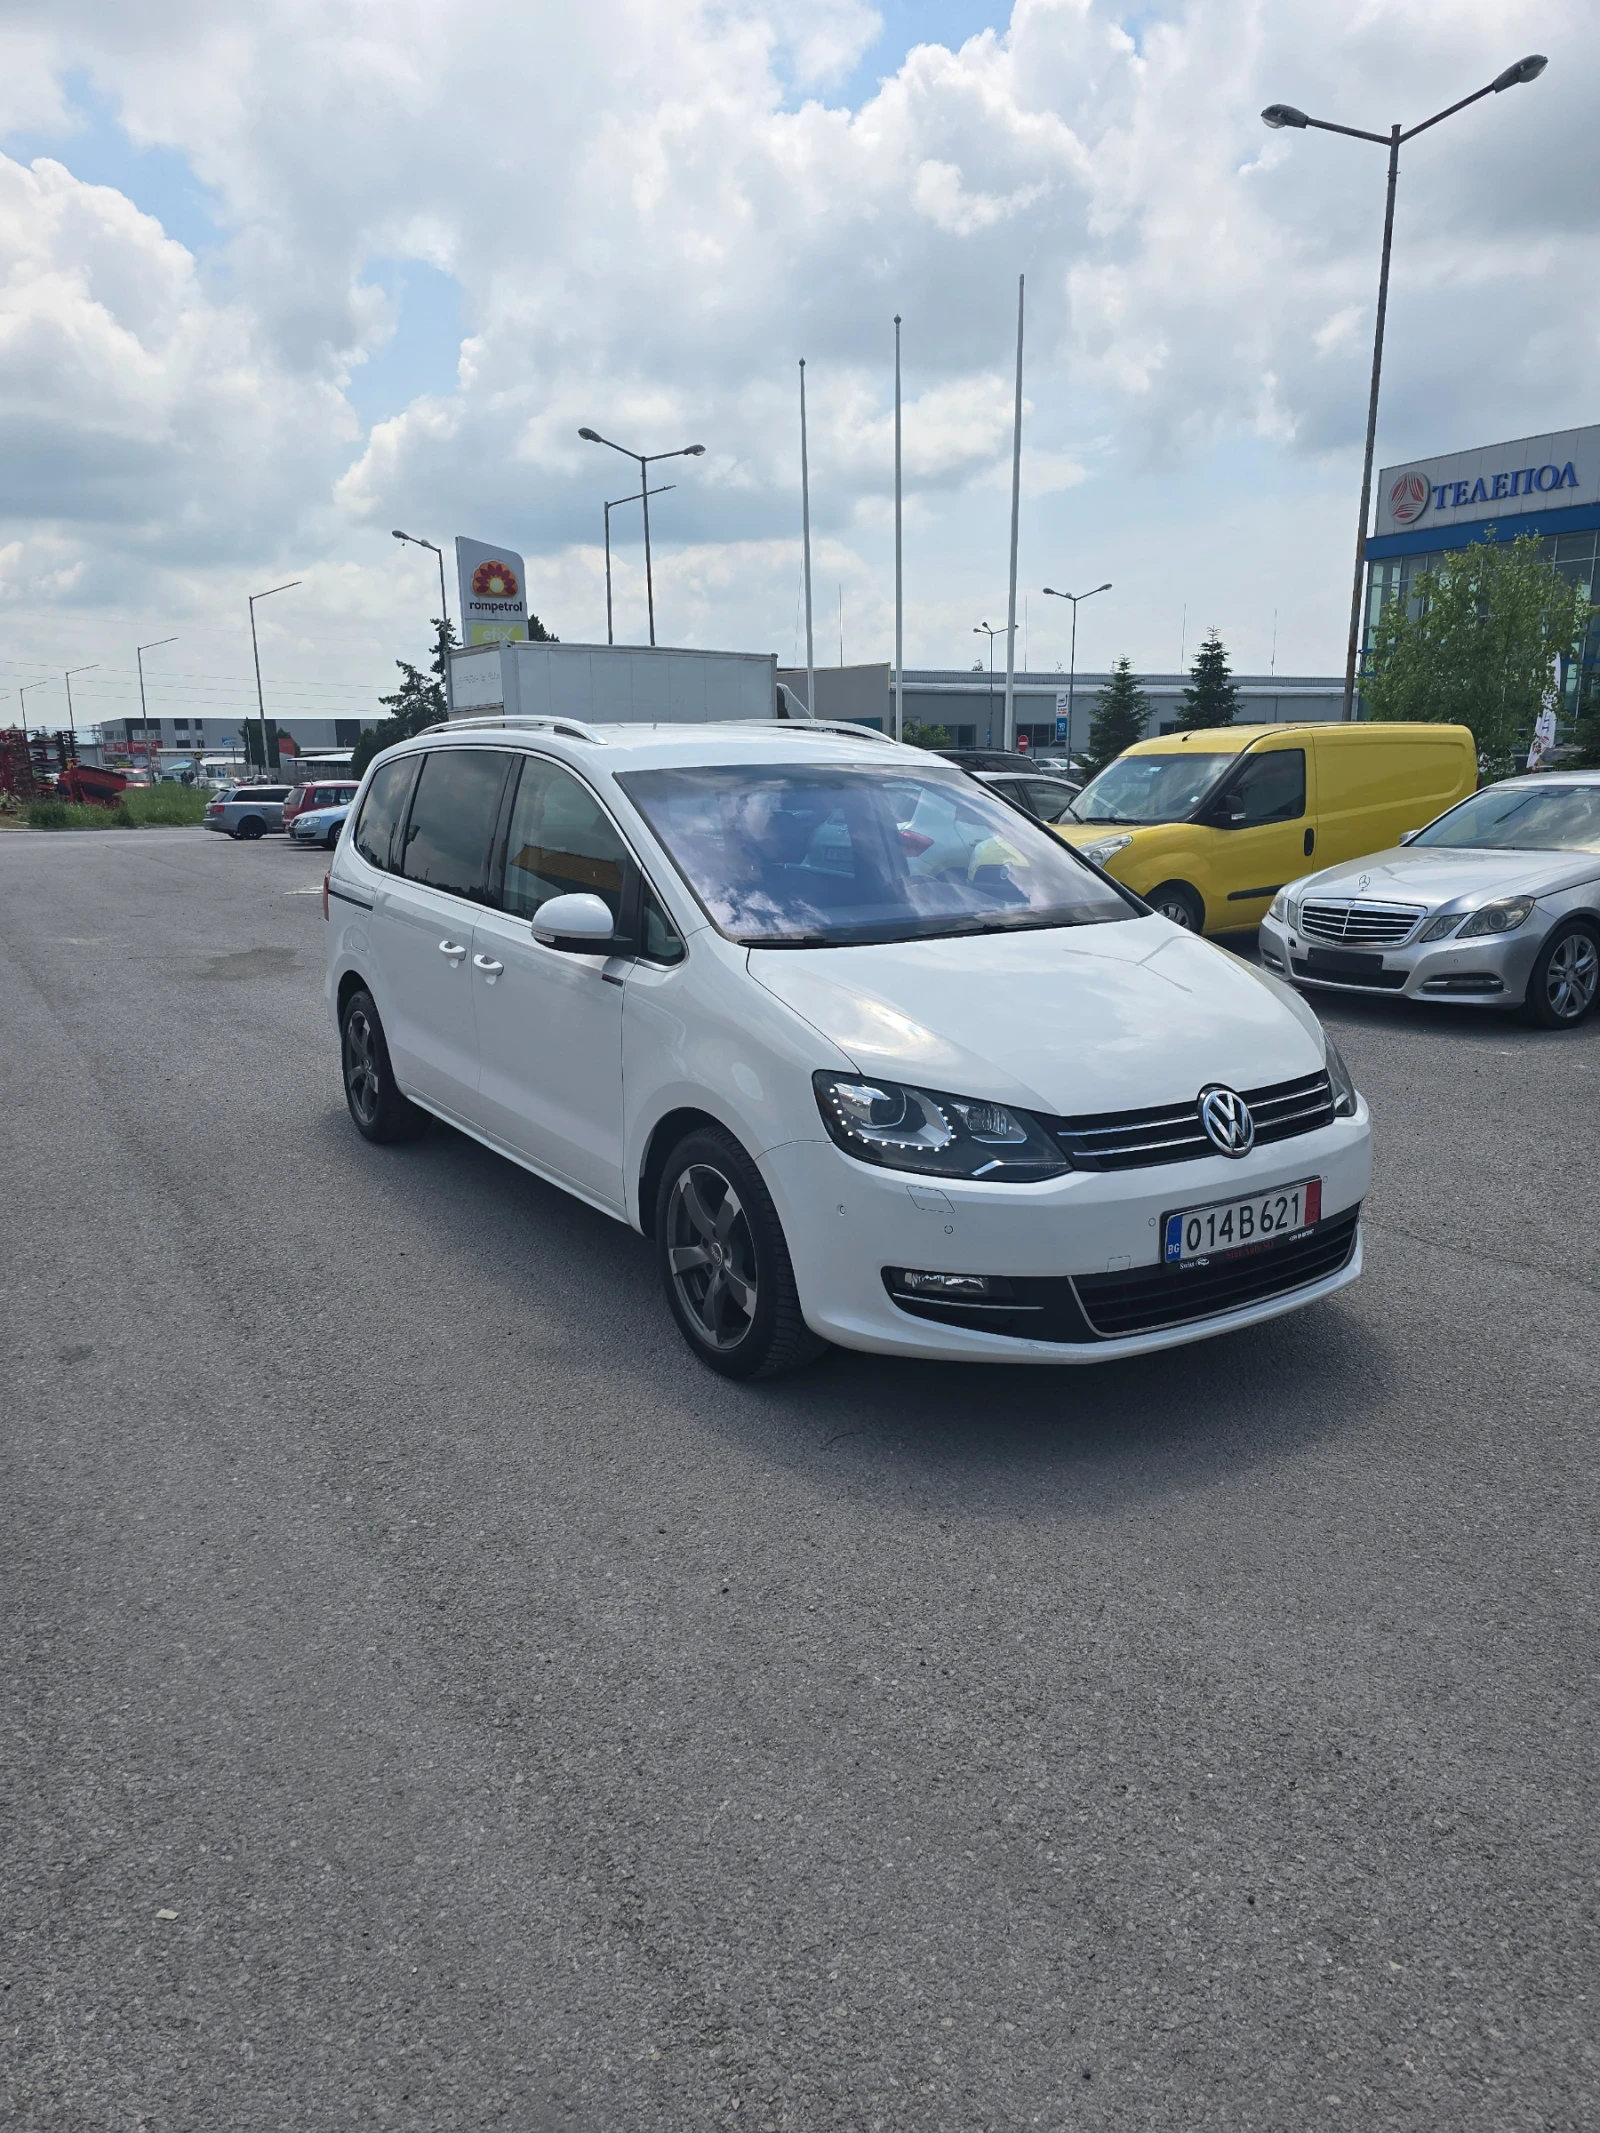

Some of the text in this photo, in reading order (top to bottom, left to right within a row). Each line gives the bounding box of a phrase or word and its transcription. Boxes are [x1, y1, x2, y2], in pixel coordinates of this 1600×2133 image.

[1432, 461, 1579, 509] ТЕЛЕПОЛ
[469, 601, 522, 613] rompetrol
[1167, 1243, 1180, 1255] BG
